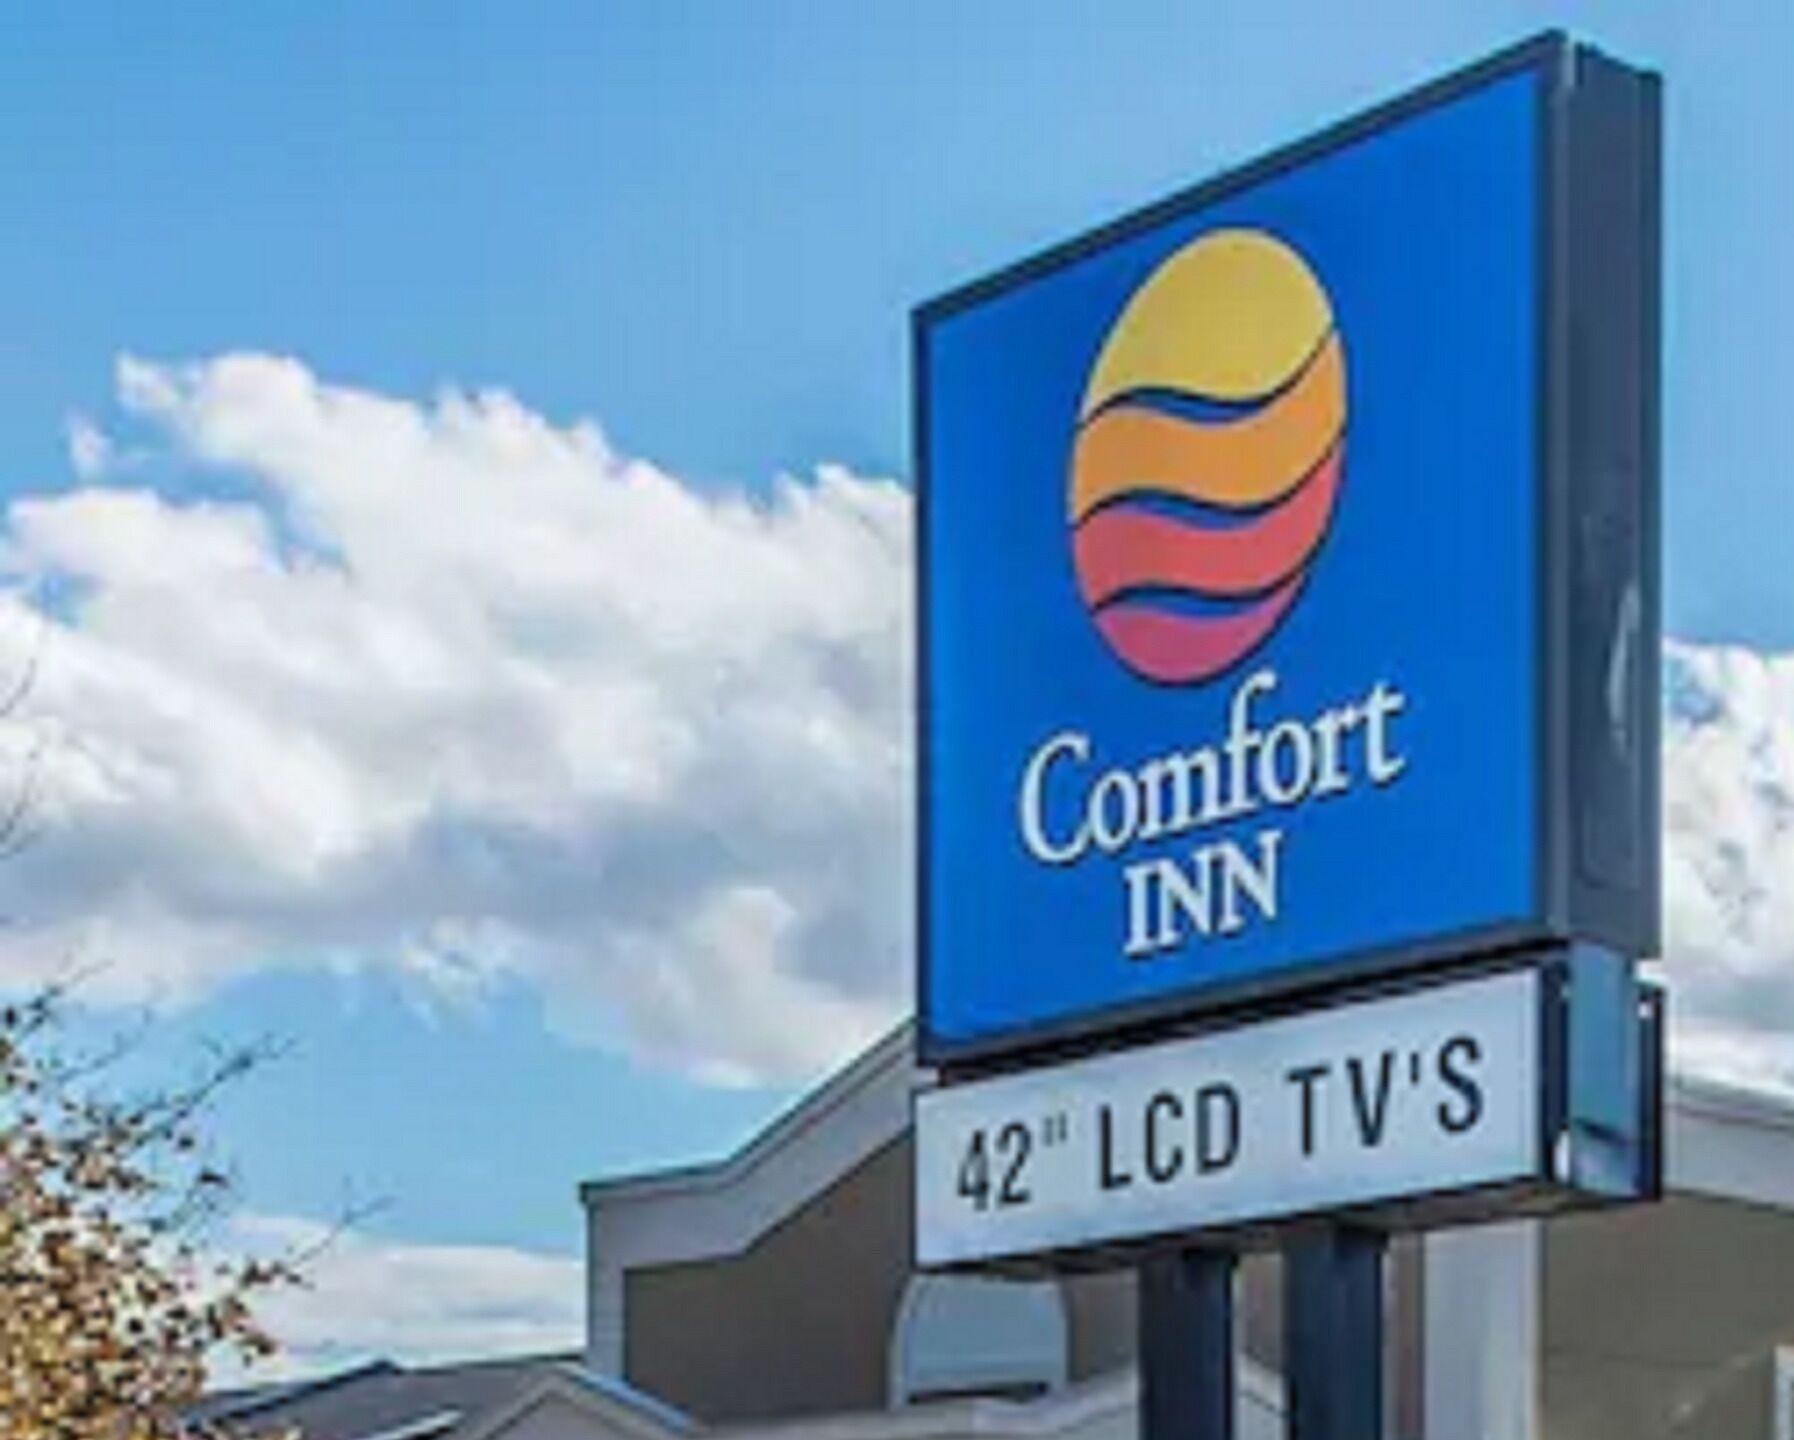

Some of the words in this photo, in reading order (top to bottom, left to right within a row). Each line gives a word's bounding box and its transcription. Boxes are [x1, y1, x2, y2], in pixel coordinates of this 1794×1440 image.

[1020, 670, 1405, 865] Comfort
[1122, 829, 1282, 958] INN
[956, 1111, 1070, 1212] 42"
[1098, 1081, 1242, 1191] LCD
[1287, 1036, 1486, 1157] TV'S
